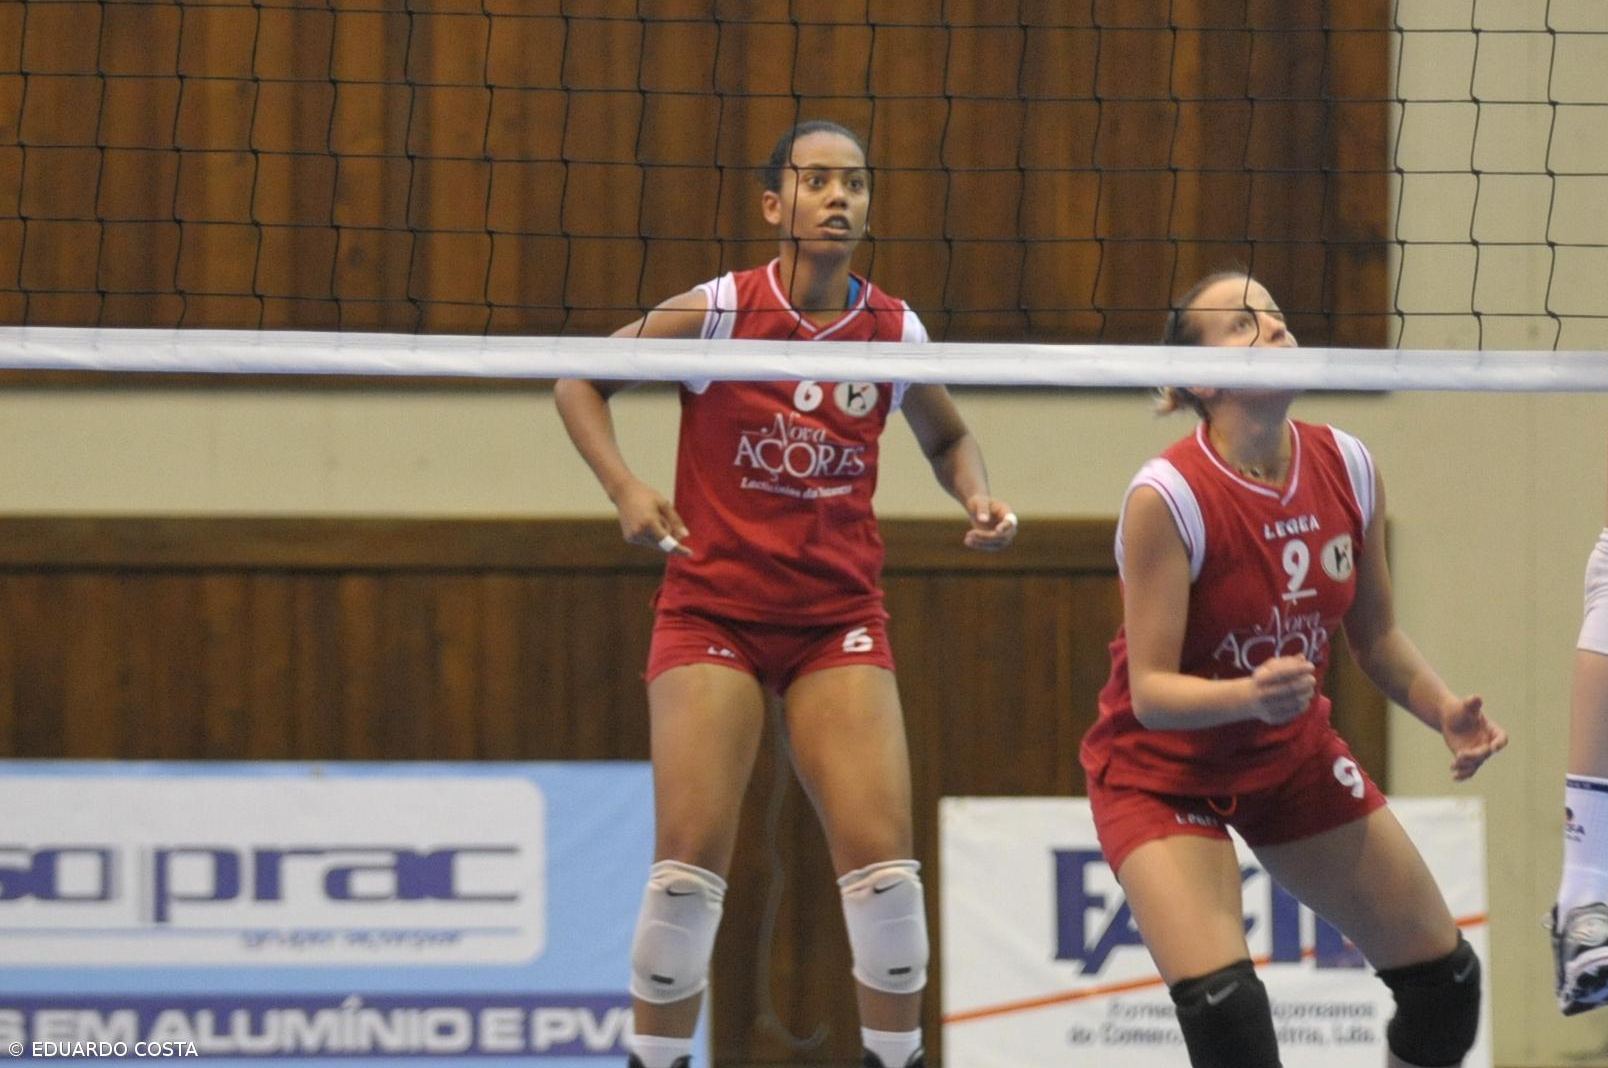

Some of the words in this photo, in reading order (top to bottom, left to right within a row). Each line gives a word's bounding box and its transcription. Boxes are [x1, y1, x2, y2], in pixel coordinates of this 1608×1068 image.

[793, 381, 824, 413] 6
[733, 434, 867, 482] AÇORES
[1282, 538, 1310, 592] 9
[842, 626, 874, 653] 6
[1333, 756, 1366, 799] 9
[32, 1008, 139, 1054] EM
[146, 994, 473, 1055] ALUMÍNIO
[479, 1007, 527, 1053] E
